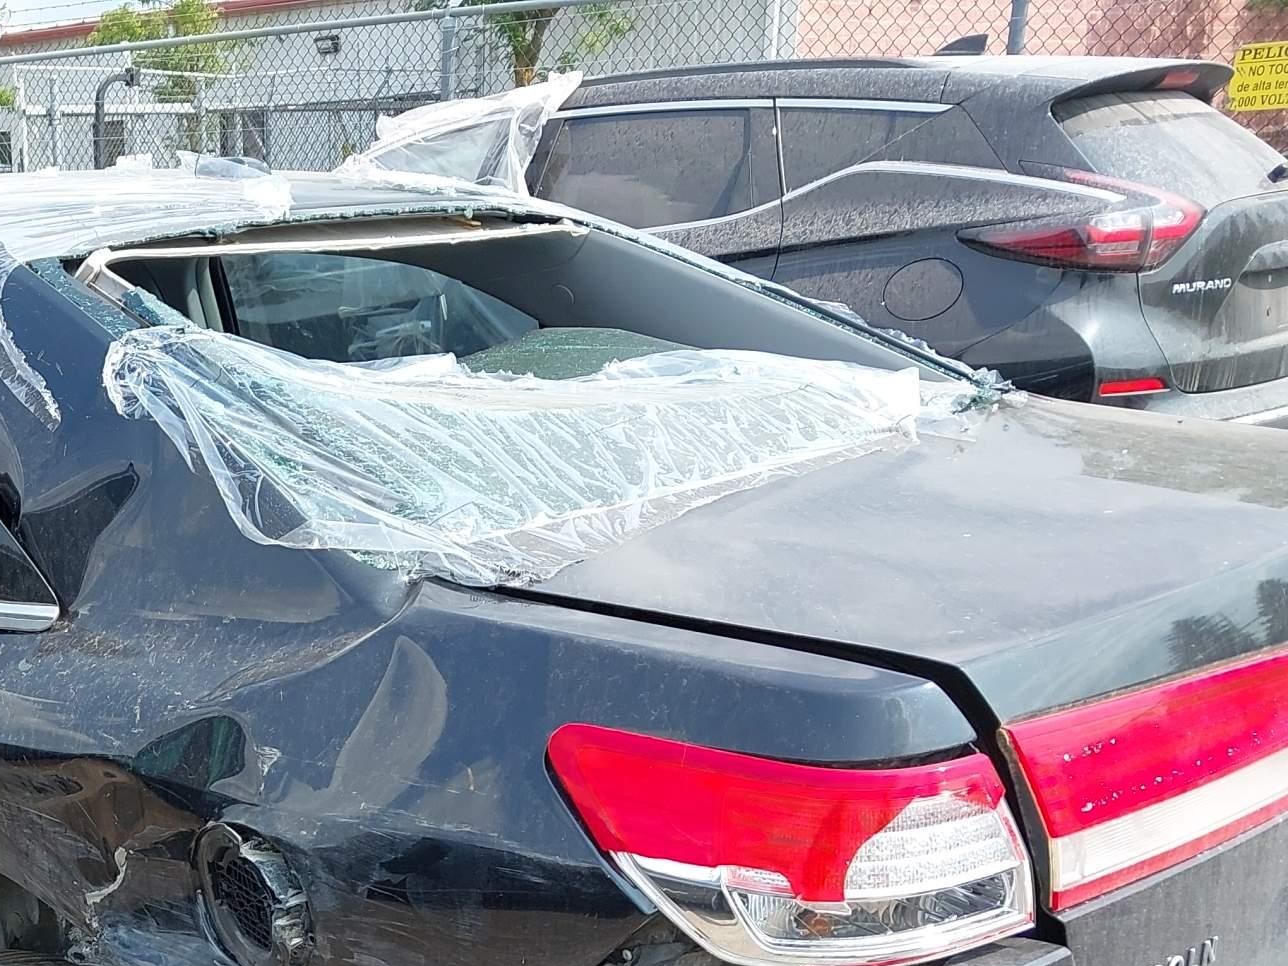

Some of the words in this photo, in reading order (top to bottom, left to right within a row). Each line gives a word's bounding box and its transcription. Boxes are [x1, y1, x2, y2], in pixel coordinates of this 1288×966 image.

[1248, 65, 1265, 77] NO
[1237, 82, 1249, 92] de
[1252, 80, 1271, 91] alta
[1172, 277, 1232, 294] MURANO
